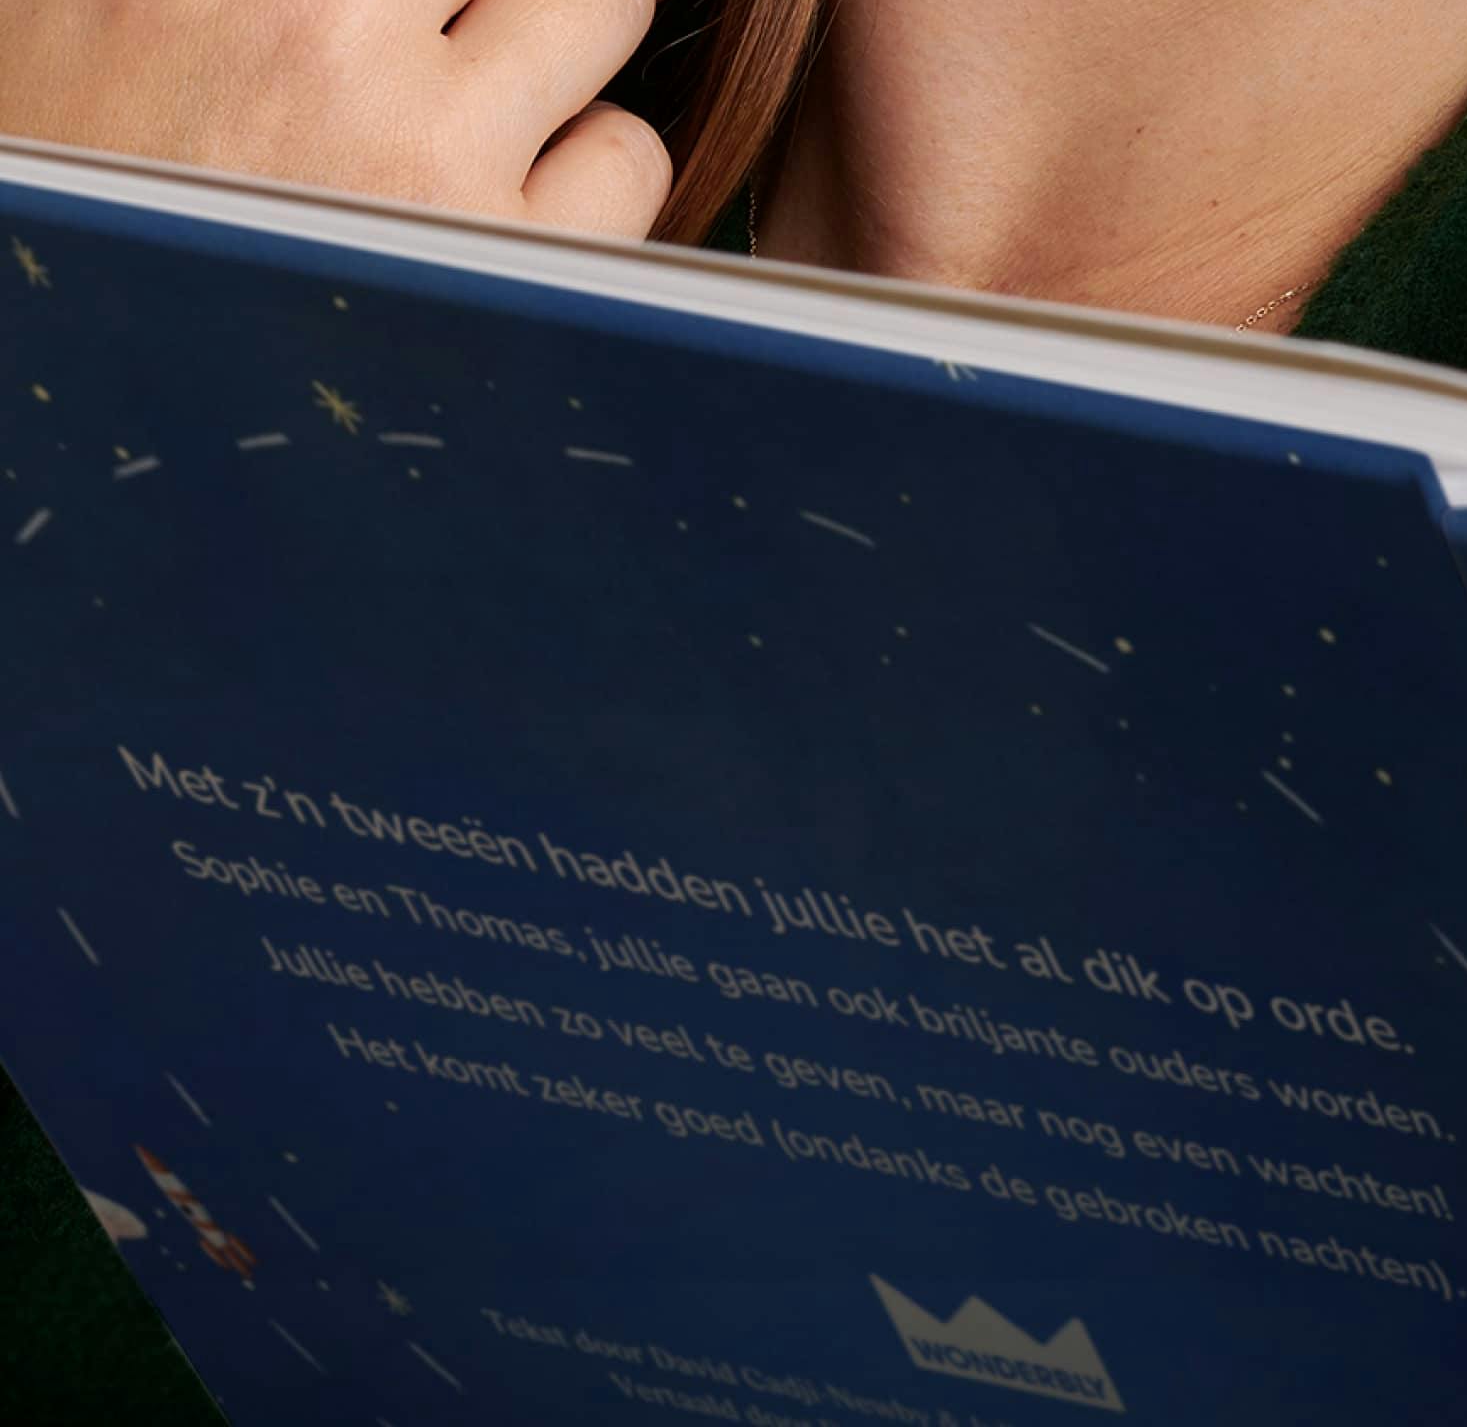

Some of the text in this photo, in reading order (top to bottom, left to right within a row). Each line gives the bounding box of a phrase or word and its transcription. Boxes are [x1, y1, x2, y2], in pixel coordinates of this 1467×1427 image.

[117, 745, 1415, 1055] Met z'n tweeën hadden jullie het al dik op orde.
[171, 840, 1455, 1142] Sophie en Thomas, jullie gaan ook briljante ouders worden.
[261, 936, 1453, 1220] Jullie hebben zo veel te geven, maar nog even wachten!
[327, 1023, 1466, 1300] Het komt zeker goed (ondanks de gebroken nachten).
[909, 1336, 1107, 1400] WONDERBLY
